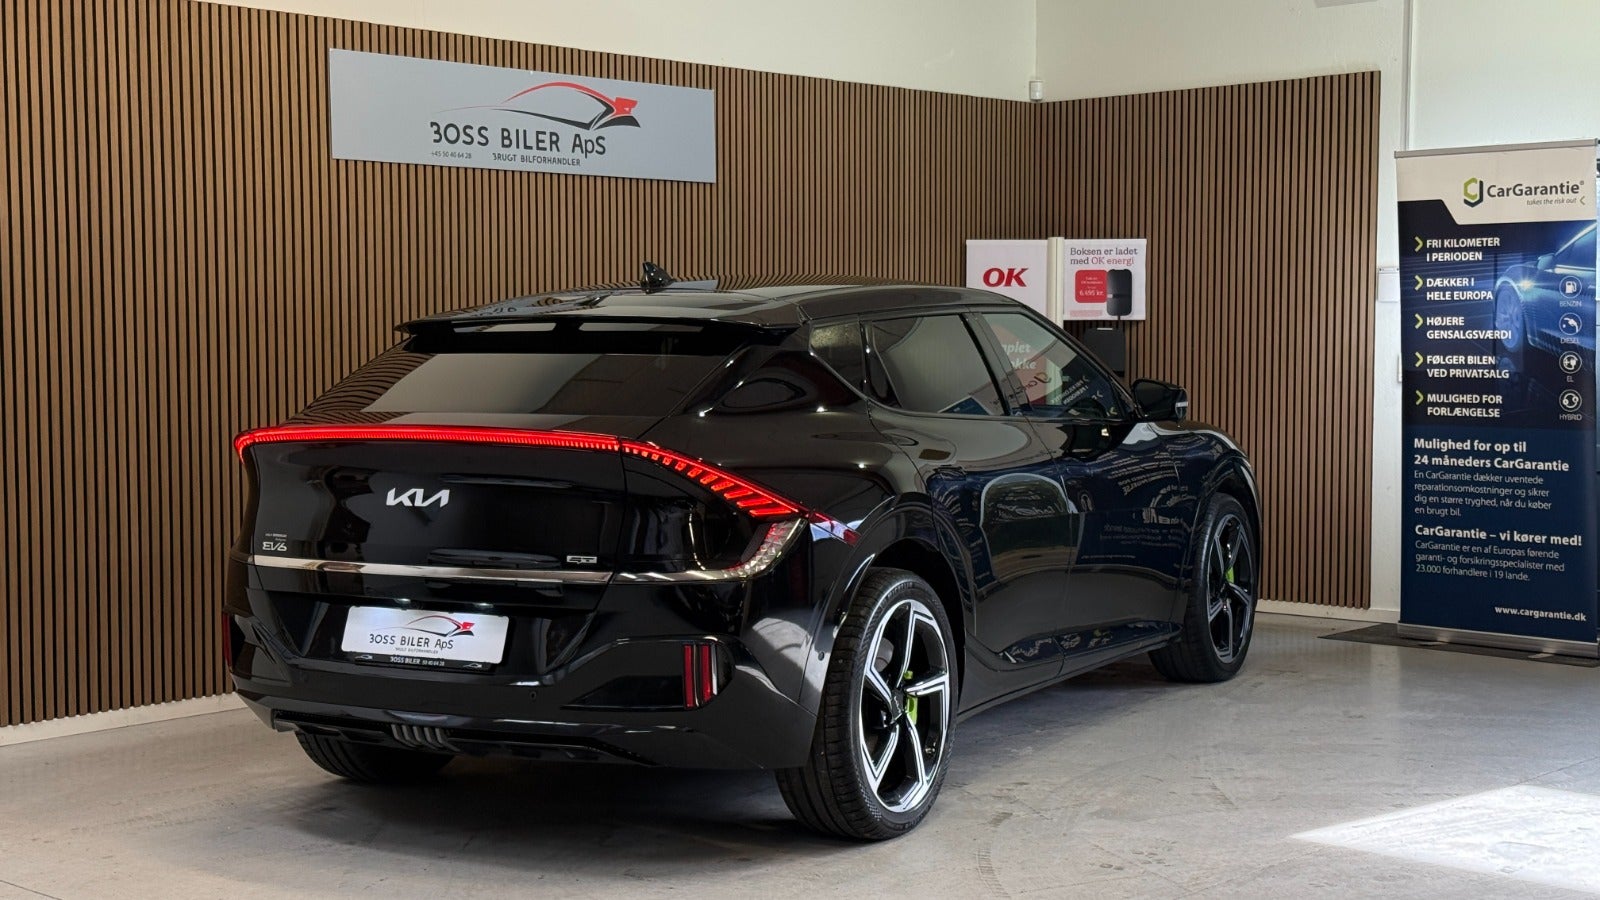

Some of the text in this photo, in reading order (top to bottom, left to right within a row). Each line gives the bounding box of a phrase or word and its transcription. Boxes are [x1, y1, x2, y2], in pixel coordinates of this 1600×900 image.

[501, 128, 560, 152] BILER
[572, 133, 606, 158] ApS
[520, 154, 580, 166] BILFORHANDLER
[1526, 198, 1542, 206] takes
[1426, 238, 1500, 248] FRI KILOMETER
[1070, 248, 1102, 256] Boksen
[1426, 252, 1482, 262] I PERIODEN
[1070, 257, 1089, 265] med
[1107, 257, 1134, 266] energi
[983, 268, 1028, 287] OK
[1426, 278, 1474, 287] DÆKKER I
[1426, 291, 1493, 300] HELE EUROPA
[1426, 316, 1464, 326] HØJERE
[1426, 330, 1512, 340] GENSALGSVÆRDI
[1427, 355, 1495, 364] FØLGER BILEN
[1427, 369, 1510, 378] VED PRIVATSALG
[1427, 394, 1502, 404] MULIGHED FOR
[1427, 407, 1500, 418] FORLÆNGELSE
[1414, 438, 1527, 454] Mulighed for op til
[1414, 454, 1570, 472] 24 måneders CarGarantie
[1426, 471, 1471, 481] CarGarantie
[1473, 472, 1502, 482] dækker
[1504, 475, 1544, 484] uventede
[1414, 483, 1550, 498] reparationsomkostninger og sikrer
[386, 487, 450, 508] KIA
[1414, 494, 1428, 504] dig
[1441, 496, 1464, 505] større
[1465, 497, 1498, 508] tryghed,
[1500, 498, 1512, 507] når
[1514, 499, 1526, 508] du
[1528, 500, 1552, 510] køber
[1426, 506, 1448, 517] brugt
[1450, 507, 1462, 517] bil.
[1415, 524, 1487, 540] CarGarantie
[1499, 531, 1511, 542] vi
[1514, 532, 1547, 544] kører
[1550, 534, 1582, 546] med!
[262, 541, 288, 552] EV6
[1415, 540, 1460, 551] CarGarantie
[1483, 545, 1492, 554] af
[1493, 546, 1526, 557] Europas
[1527, 548, 1560, 559] førende
[1415, 553, 1565, 572] garanti- og forsikringsspecialister med
[1416, 564, 1441, 573] 23.000
[1443, 565, 1488, 578] forhandlere
[1506, 572, 1530, 581] lande.
[1495, 606, 1587, 622] www.cargarantie.dk
[400, 636, 430, 648] BILER
[435, 639, 454, 650] ApS
